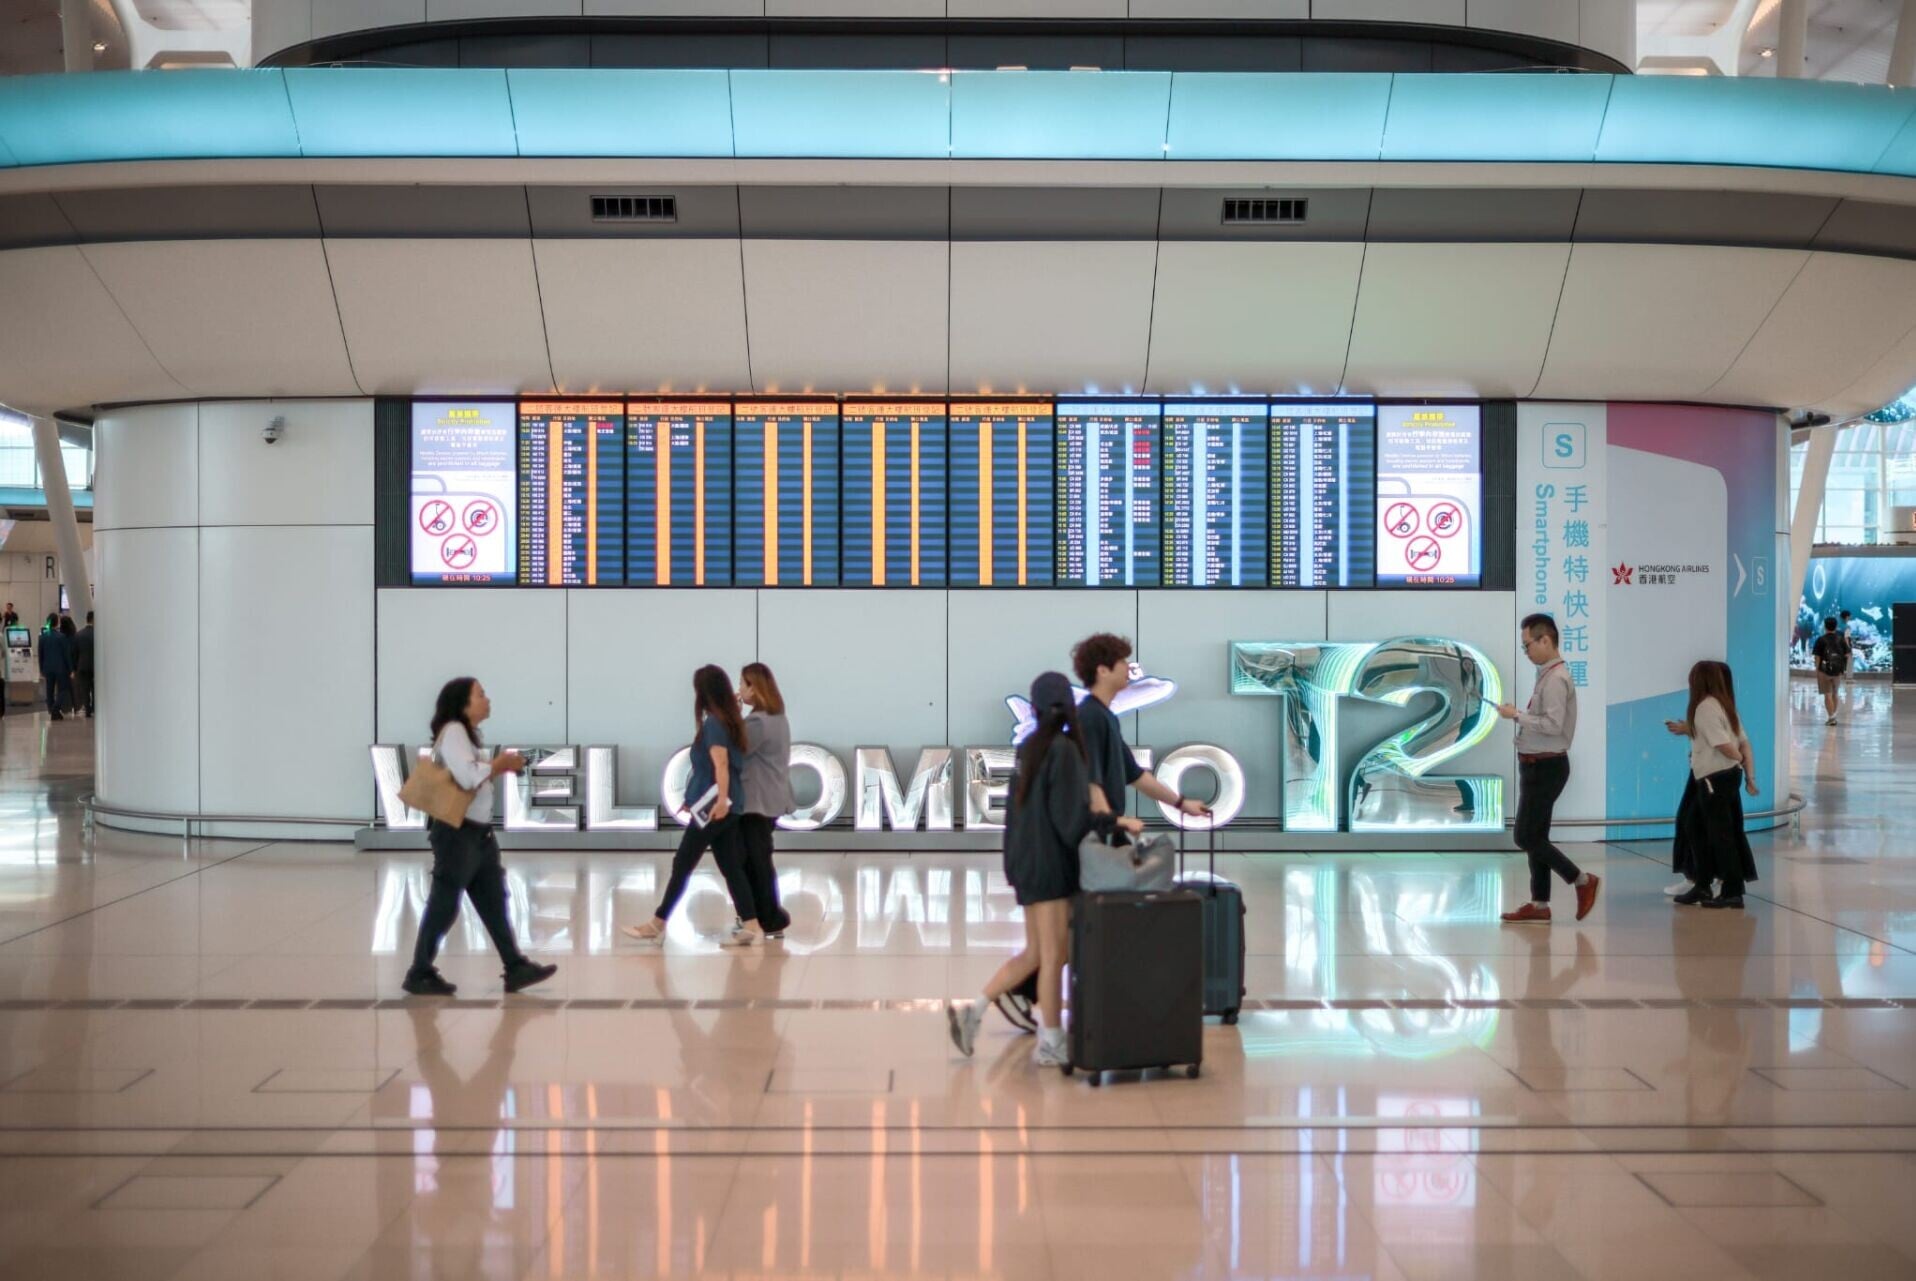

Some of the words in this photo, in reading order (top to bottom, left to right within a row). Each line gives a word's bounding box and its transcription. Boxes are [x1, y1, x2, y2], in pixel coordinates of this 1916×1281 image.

[1554, 433, 1573, 458] S
[1531, 483, 1554, 604] Smartphone
[45, 556, 56, 579] R
[1638, 564, 1680, 573] HONGKONG
[1681, 564, 1710, 573] AIRLINES
[1638, 574, 1676, 585] 香港航空
[1756, 566, 1764, 586] S
[1562, 484, 1589, 688] 手機特快託運
[1136, 743, 1246, 832] O
[1228, 636, 1504, 832] T2
